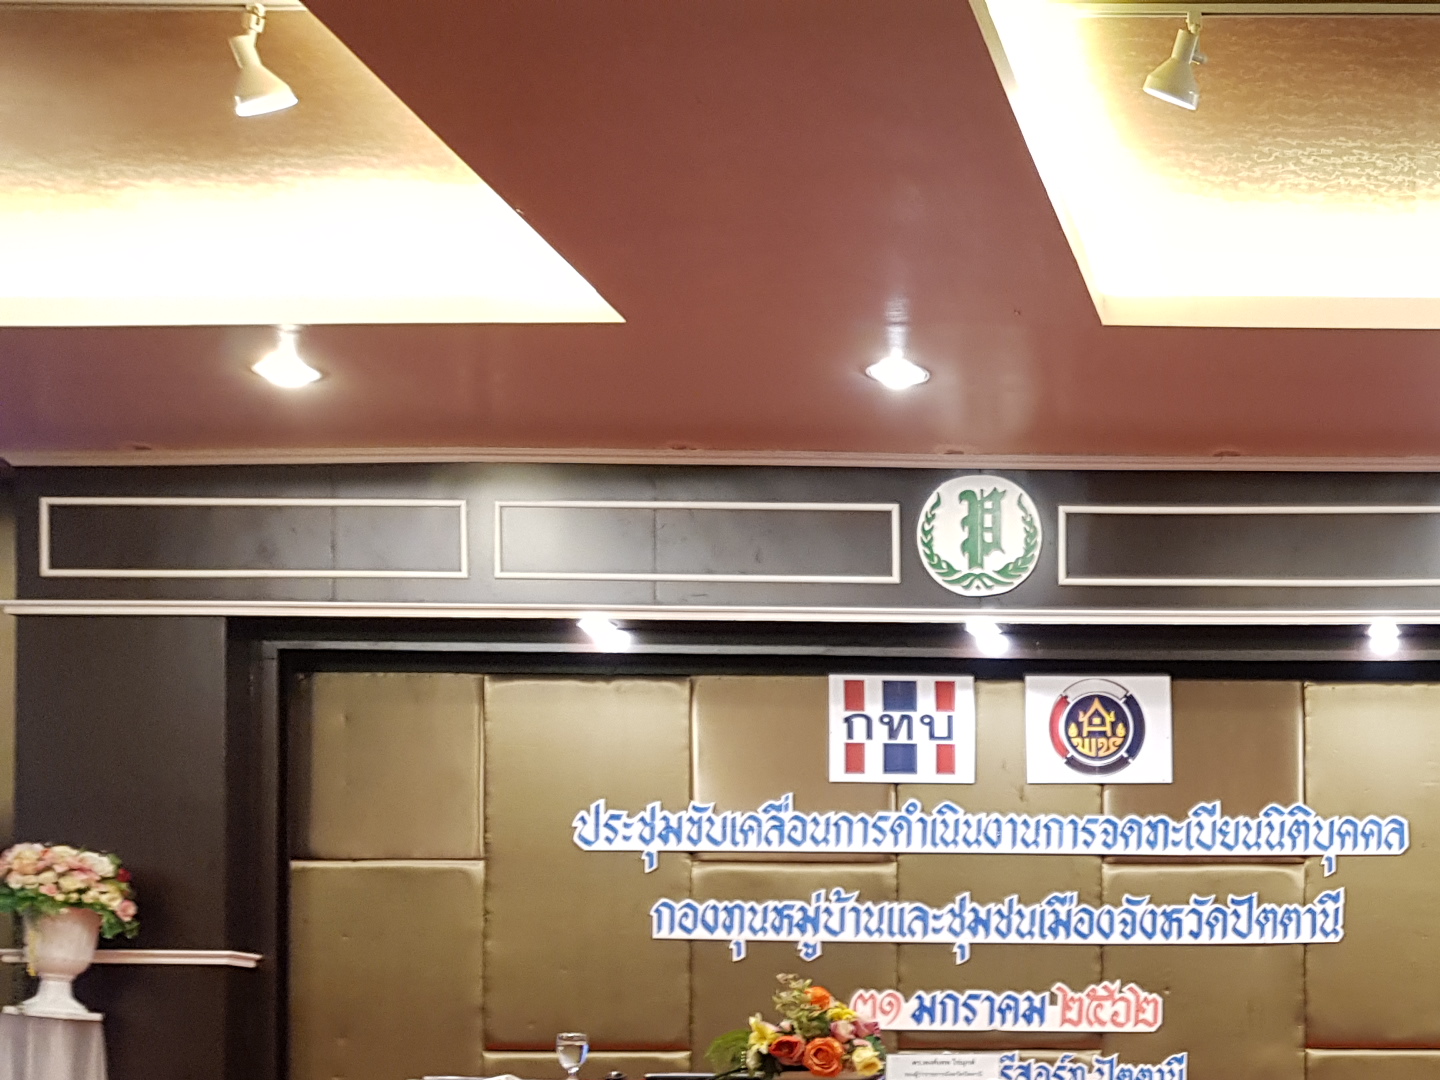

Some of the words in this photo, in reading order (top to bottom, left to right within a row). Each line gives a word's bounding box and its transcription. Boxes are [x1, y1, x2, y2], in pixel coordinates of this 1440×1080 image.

[959, 487, 1006, 570] P
[843, 713, 953, 741] กทบ
[653, 890, 1342, 962] กองทุนหมู่บ้านและชุมชนเมืองจังหวัดปัตตานี
[854, 992, 902, 1025] ๓๑
[911, 992, 1046, 1027] มกราคม
[1055, 984, 1159, 1028] ๒๕๖๒
